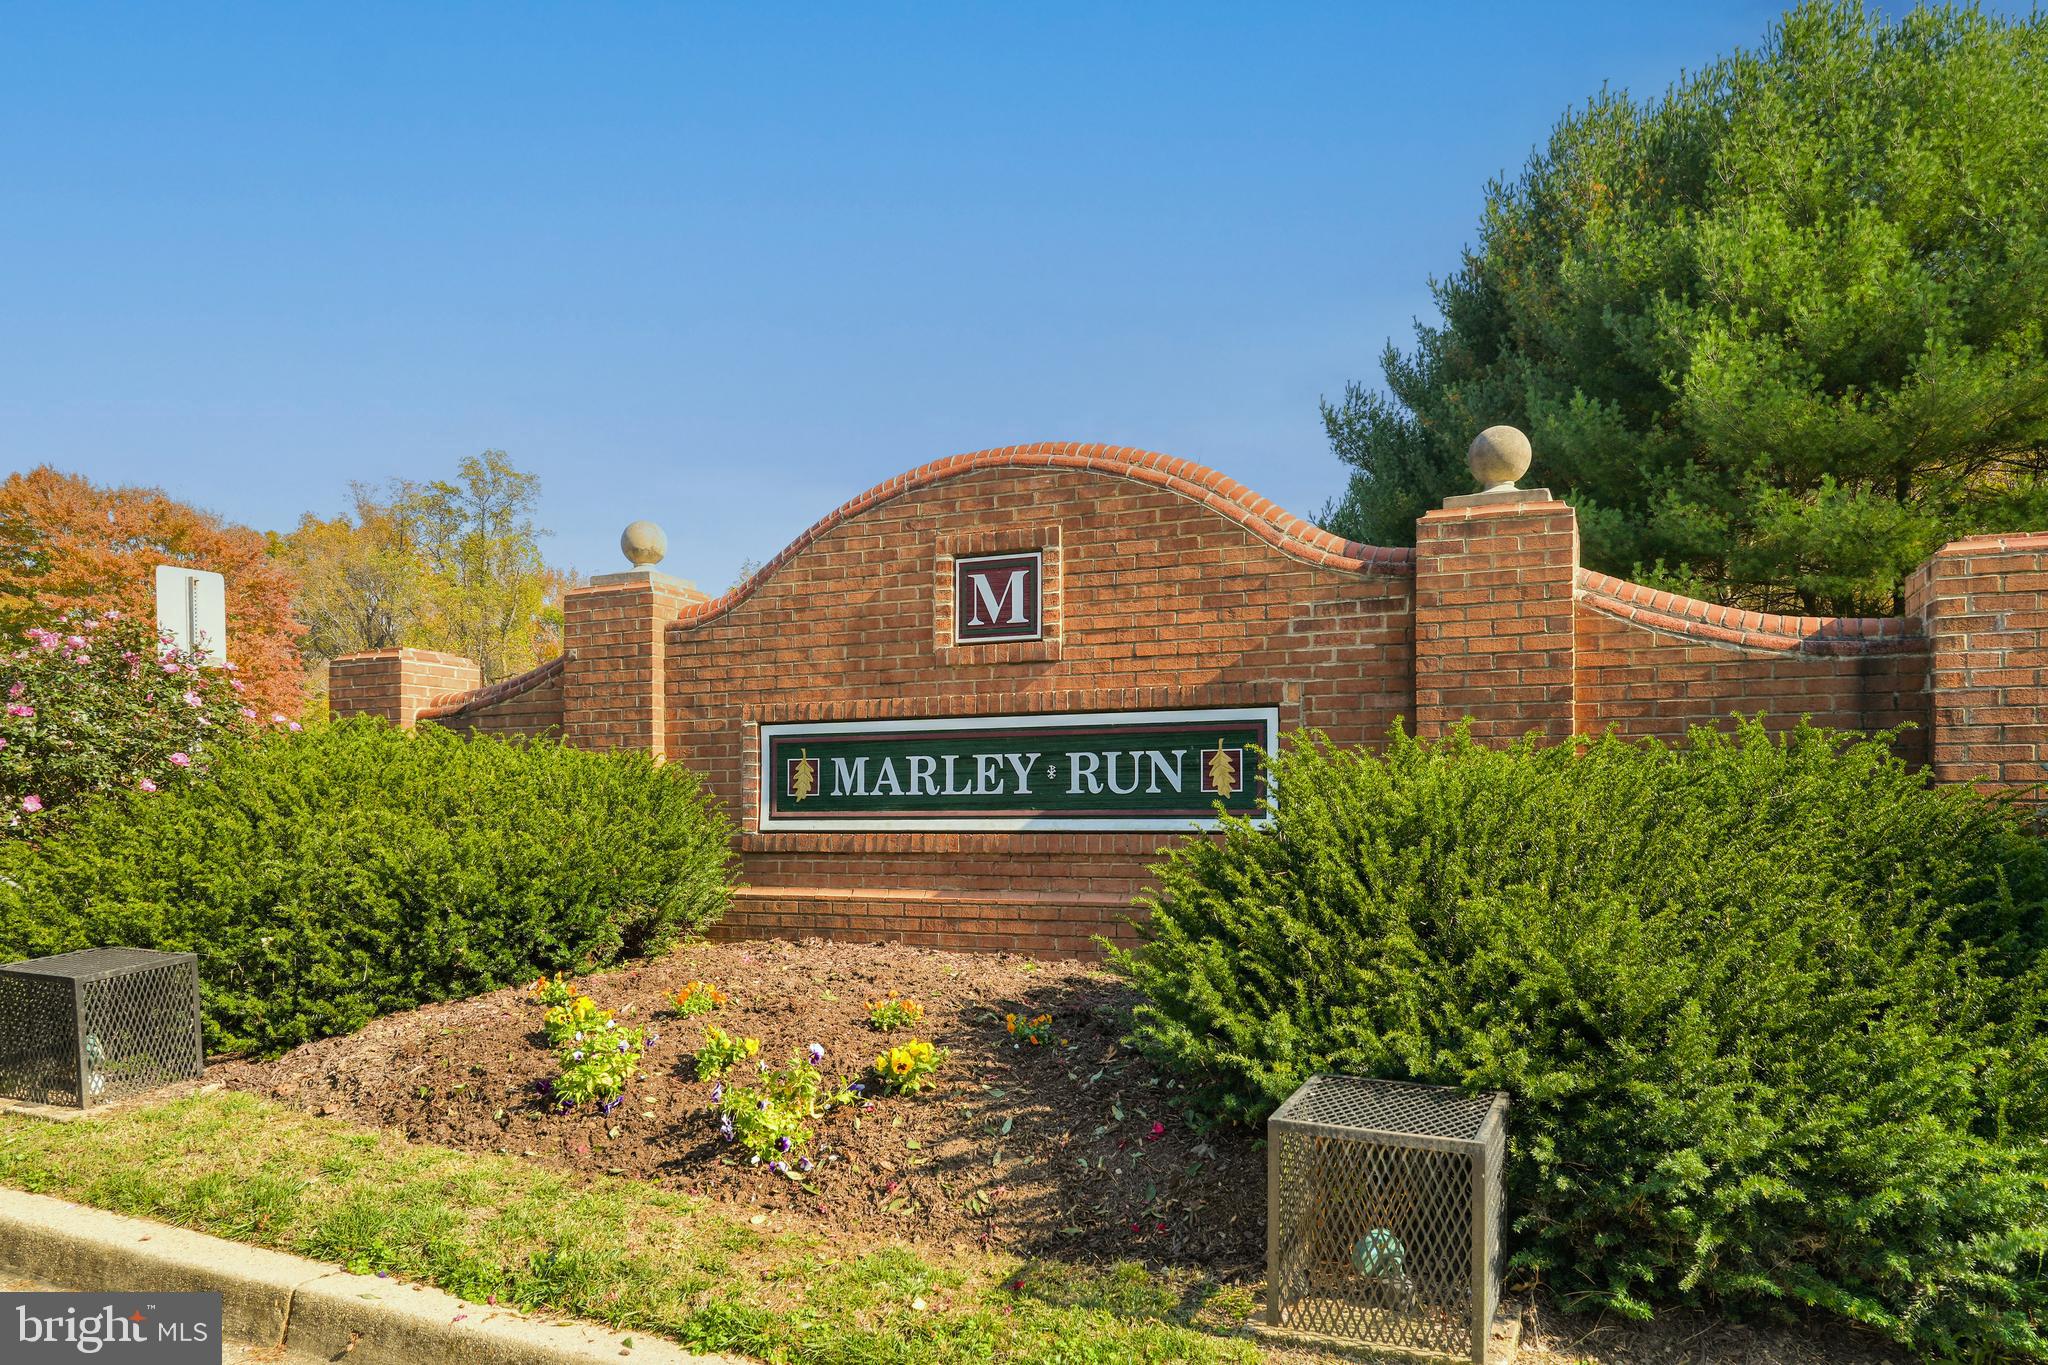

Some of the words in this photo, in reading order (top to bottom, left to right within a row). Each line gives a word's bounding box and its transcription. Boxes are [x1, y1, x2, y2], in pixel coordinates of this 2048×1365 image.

[967, 569, 1031, 627] M
[830, 752, 1042, 797] MARLEY
[1065, 749, 1188, 795] RUN
